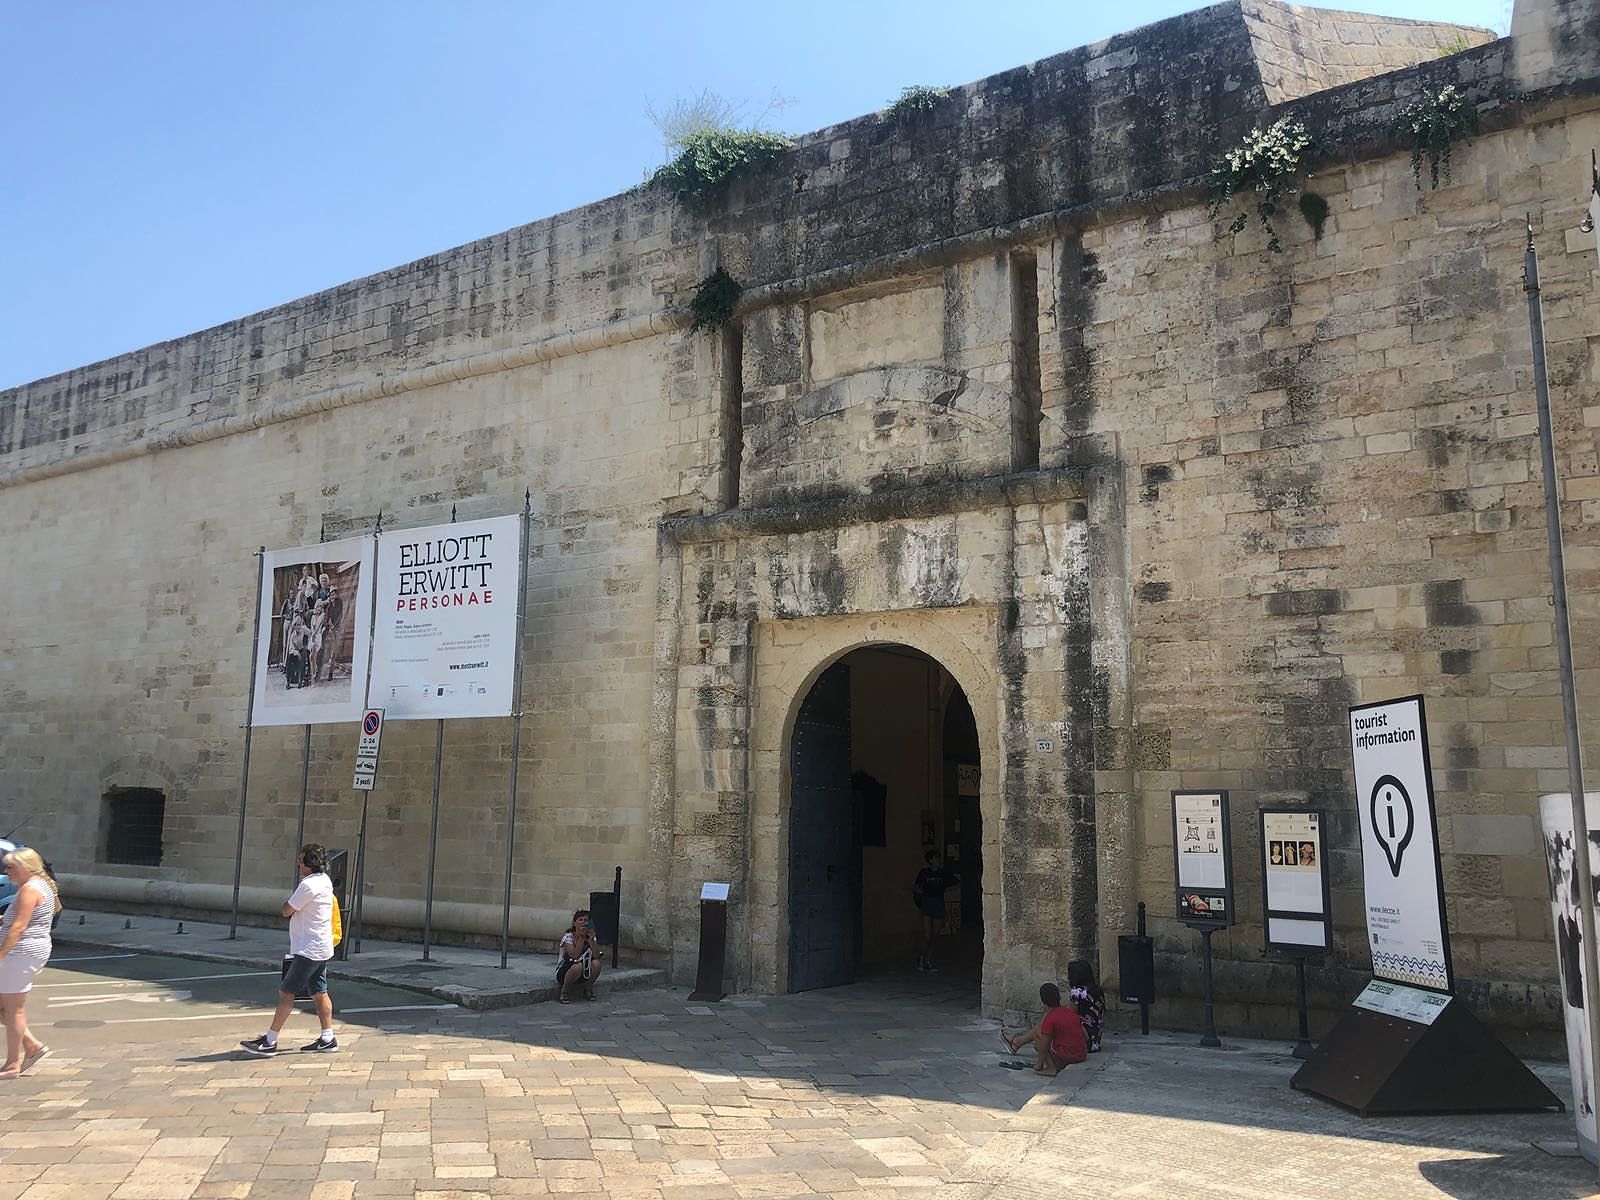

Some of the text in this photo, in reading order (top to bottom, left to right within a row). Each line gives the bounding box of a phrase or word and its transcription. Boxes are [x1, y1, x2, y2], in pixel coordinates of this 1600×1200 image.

[399, 534, 493, 568] ELLIOTT
[398, 562, 493, 596] ERWITT
[396, 591, 493, 612] PERSONAE
[1355, 712, 1388, 730] tourist
[1355, 727, 1416, 750] information
[356, 777, 360, 785] 2
